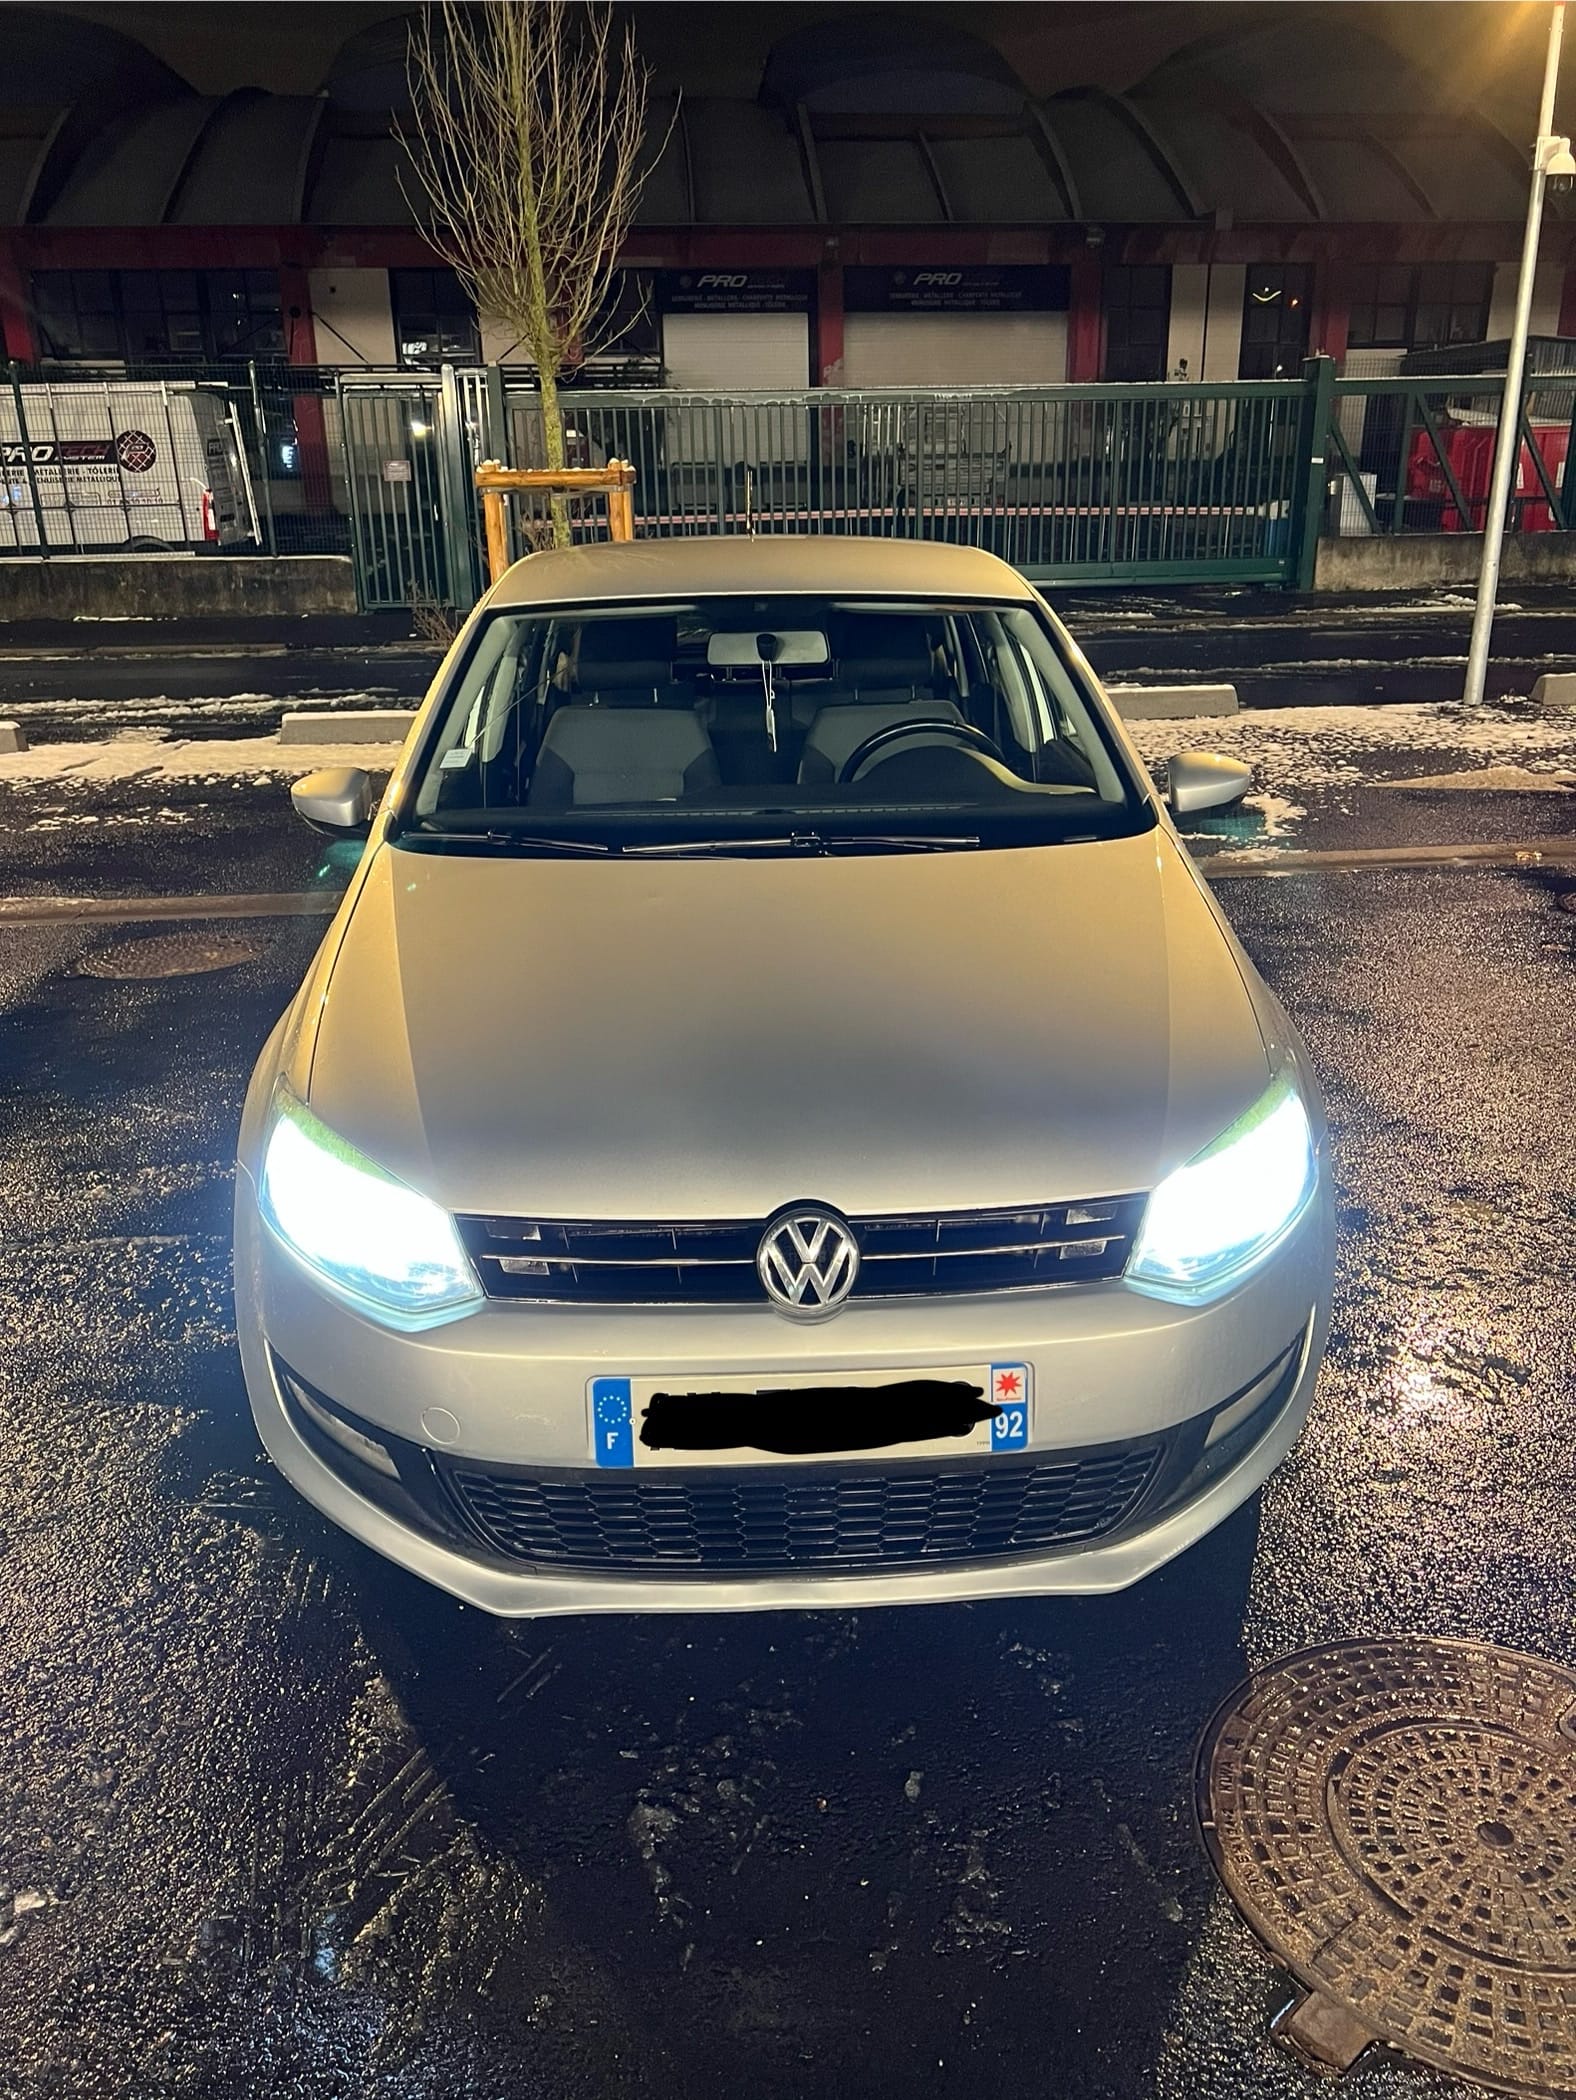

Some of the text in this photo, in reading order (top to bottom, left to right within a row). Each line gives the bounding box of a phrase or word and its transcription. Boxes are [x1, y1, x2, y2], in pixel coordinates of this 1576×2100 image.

[697, 274, 748, 288] PRO
[913, 273, 963, 285] PRO
[995, 1411, 1023, 1438] 92
[606, 1432, 619, 1450] F
